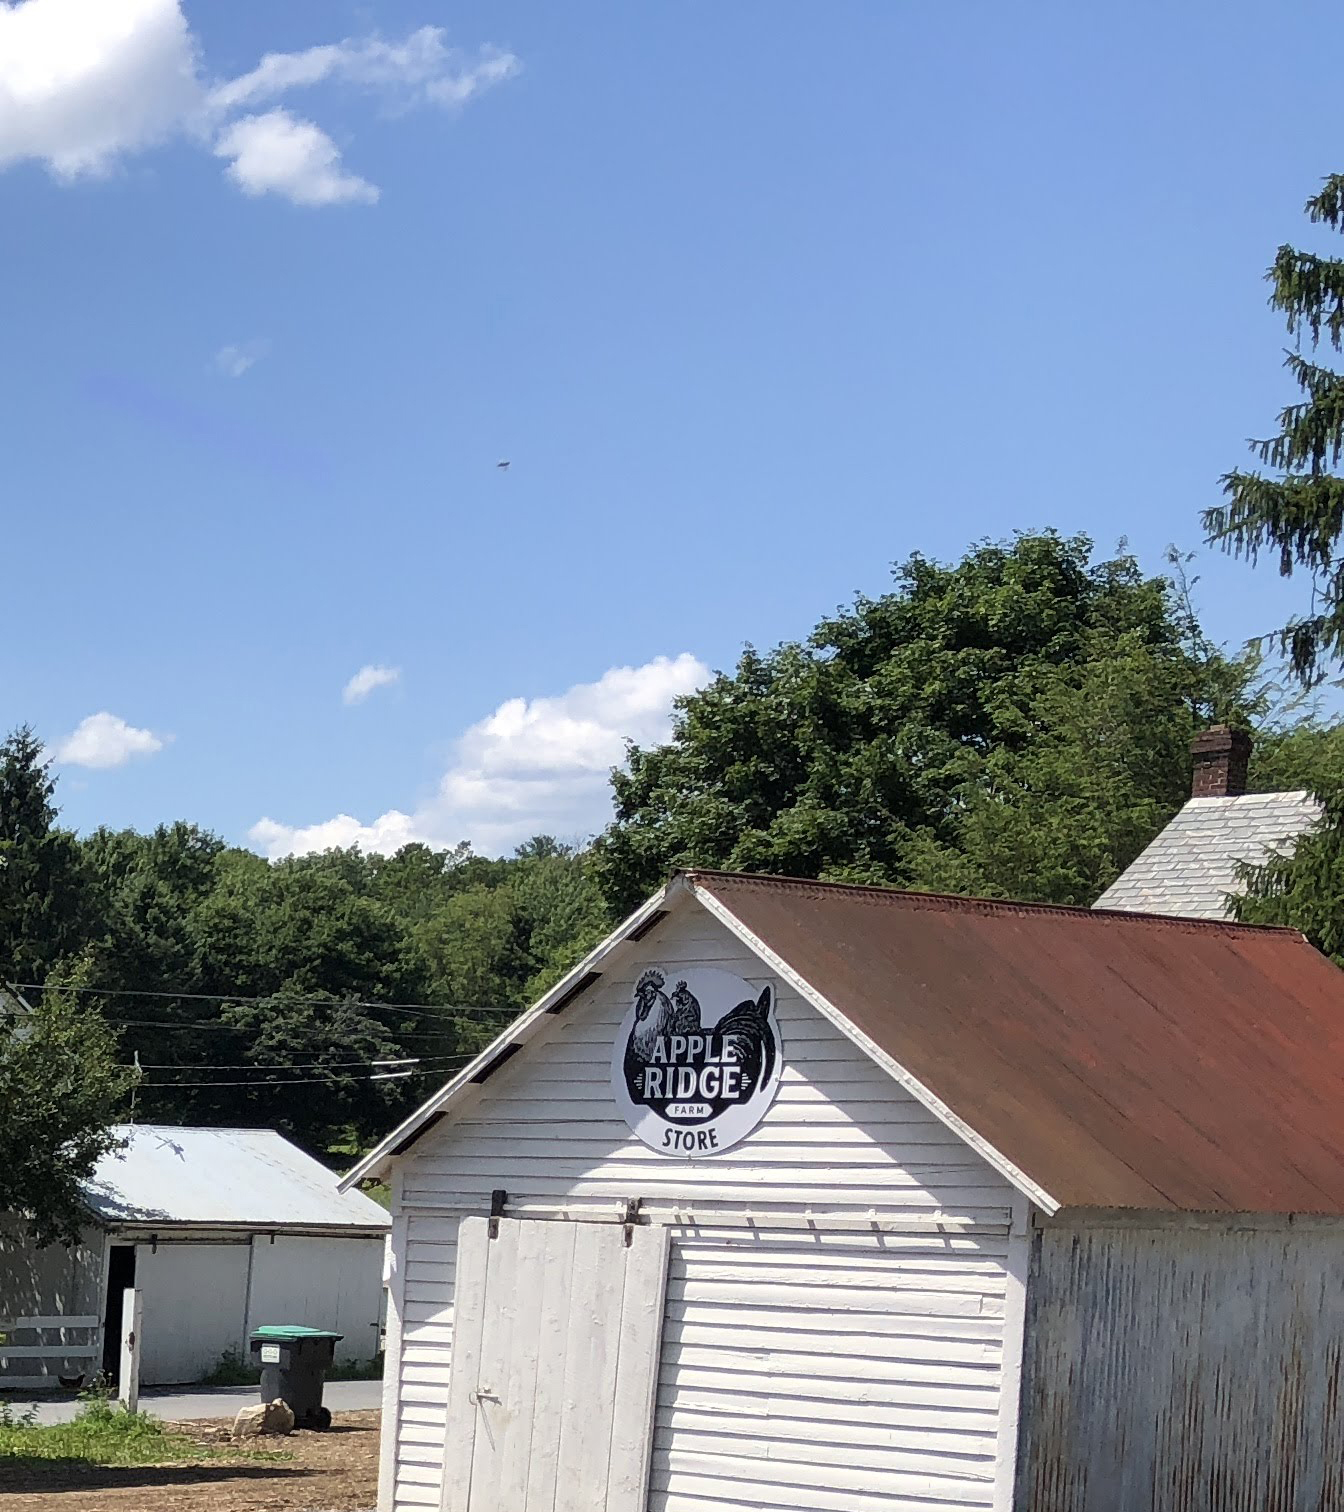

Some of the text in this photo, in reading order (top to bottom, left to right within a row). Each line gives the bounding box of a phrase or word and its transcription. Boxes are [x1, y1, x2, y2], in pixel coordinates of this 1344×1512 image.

[649, 1035, 737, 1063] APPLE
[643, 1066, 741, 1099] RIDGE
[674, 1106, 704, 1115] FARM
[662, 1128, 719, 1150] STORE
